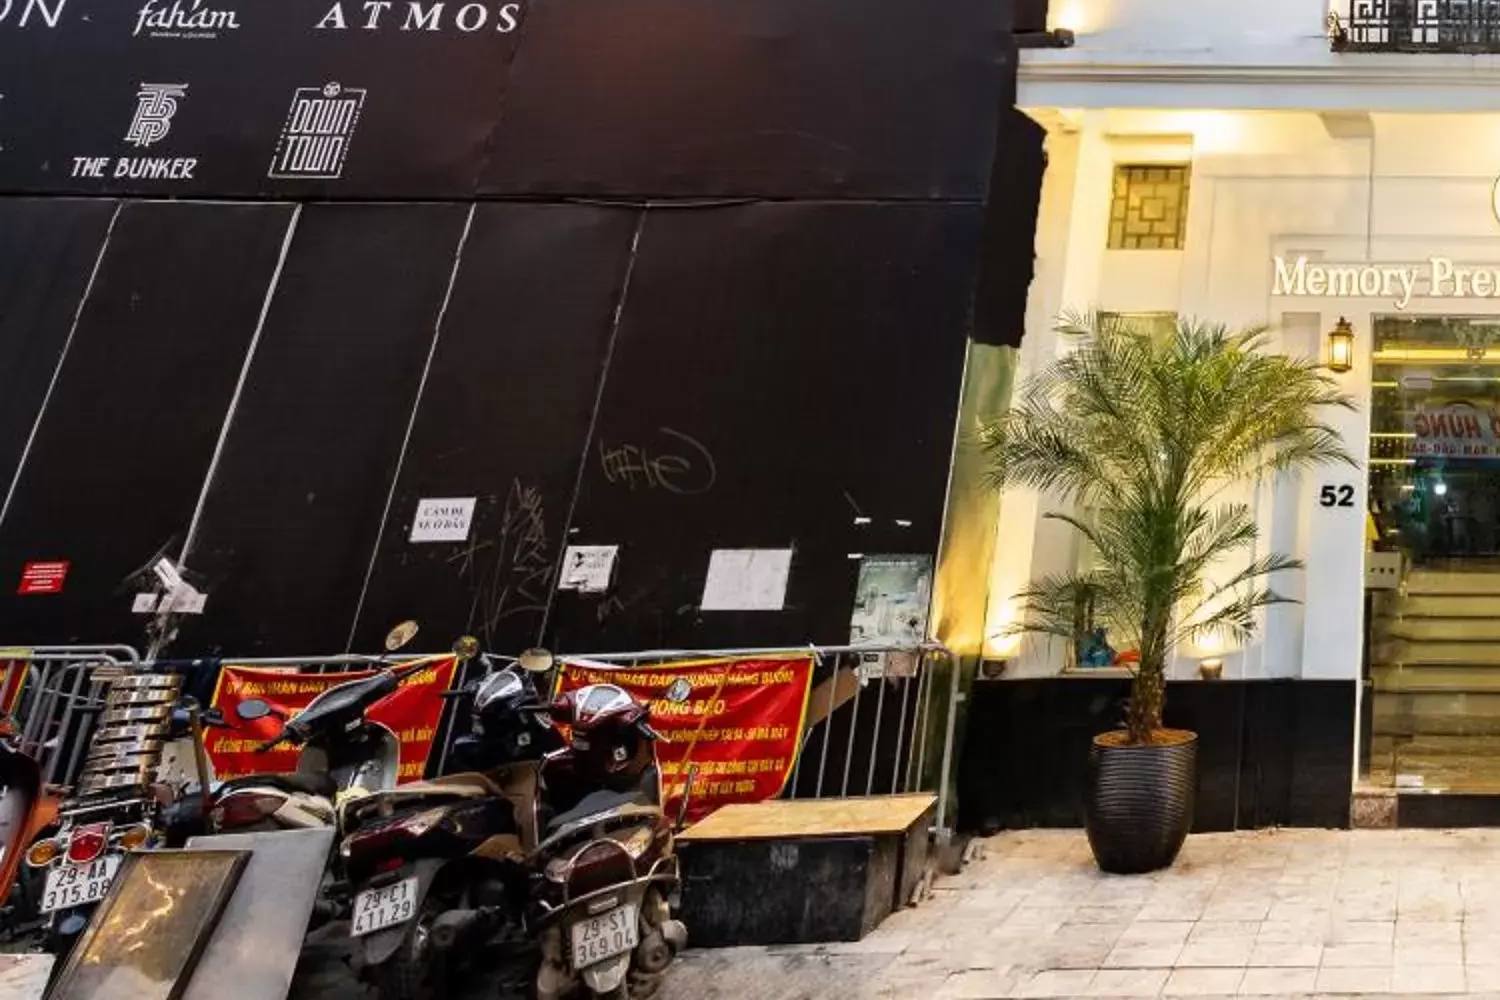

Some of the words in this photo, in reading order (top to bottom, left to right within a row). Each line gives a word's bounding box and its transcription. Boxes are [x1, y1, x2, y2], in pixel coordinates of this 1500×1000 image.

[314, 1, 520, 33] ATMOS
[71, 156, 110, 178] THE
[114, 156, 198, 180] BUNKER
[279, 135, 345, 171] TOWN
[1270, 256, 1419, 310] Memory
[1320, 484, 1354, 507] 52
